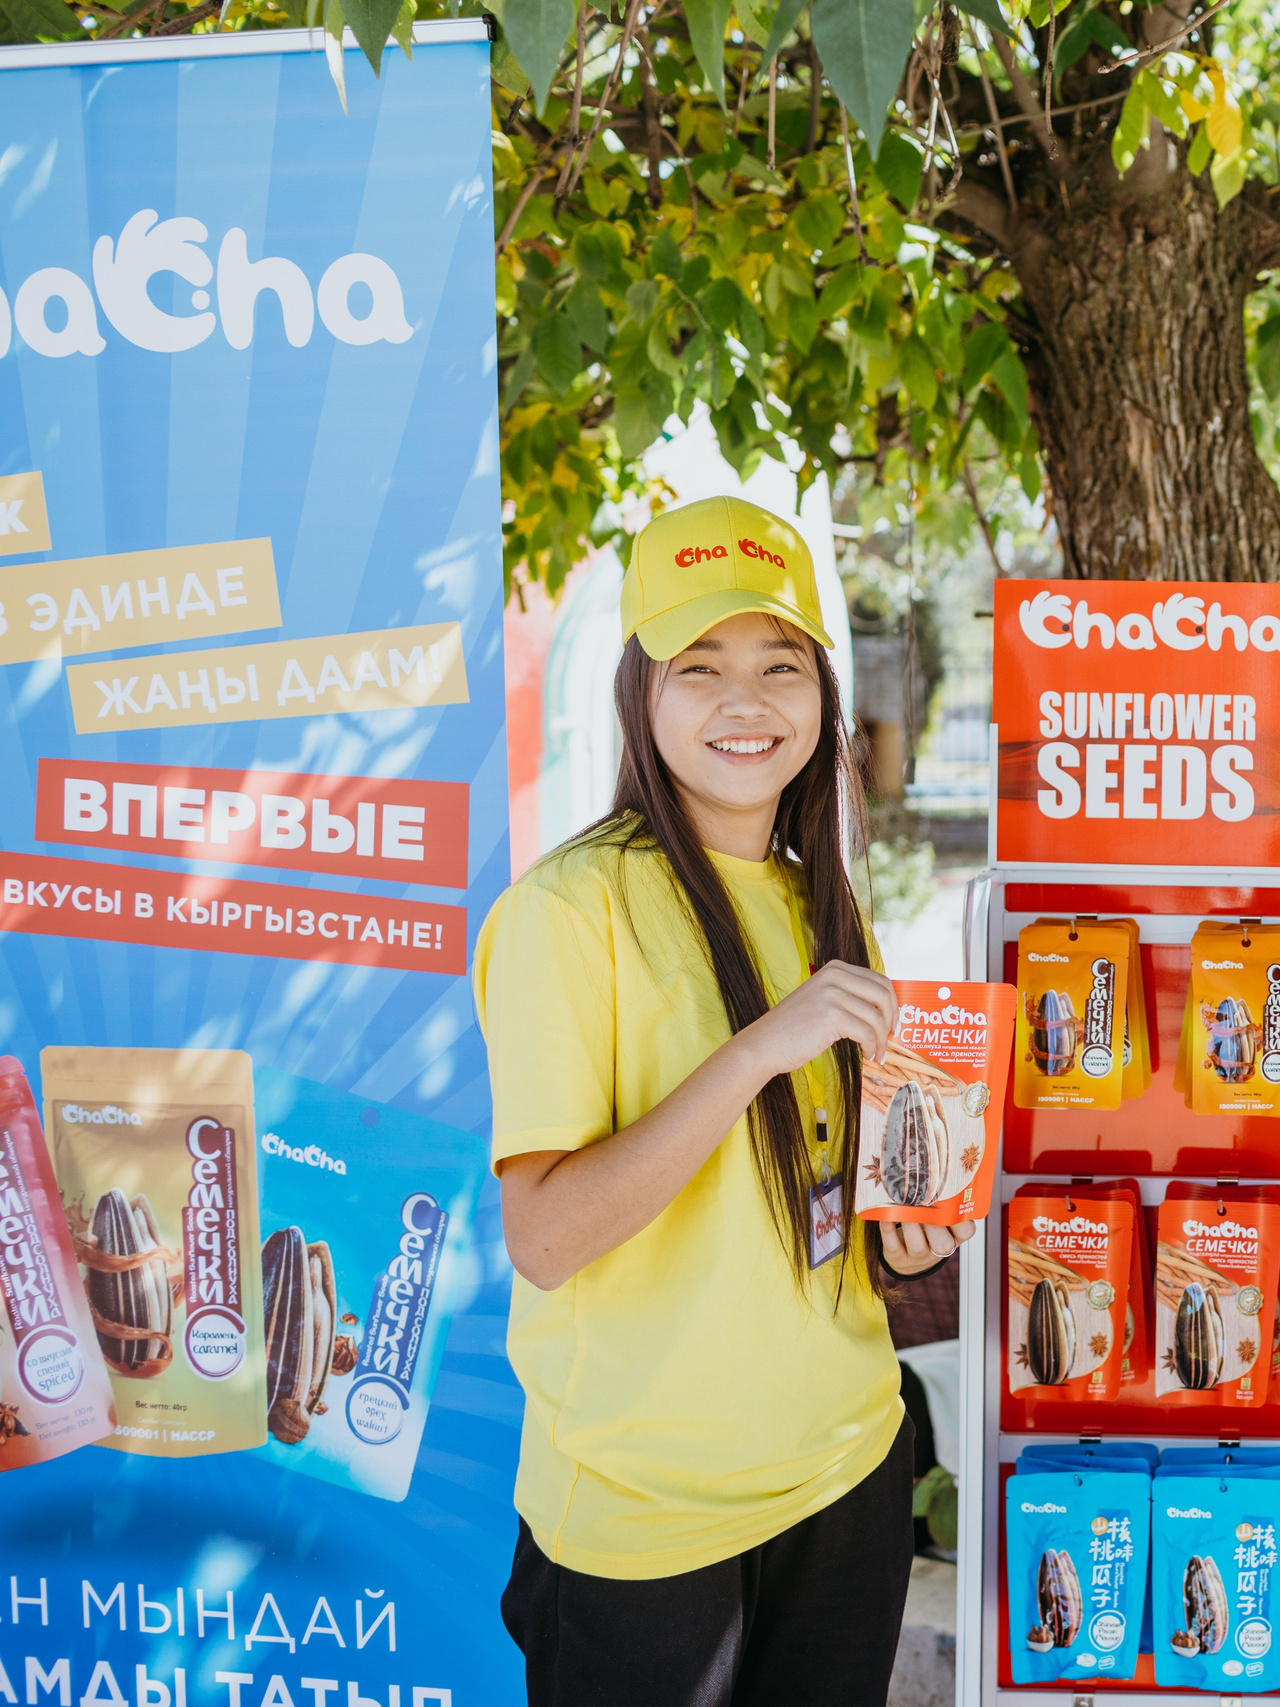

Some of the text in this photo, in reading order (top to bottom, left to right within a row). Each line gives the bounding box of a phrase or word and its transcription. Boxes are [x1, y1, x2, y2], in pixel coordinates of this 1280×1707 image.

[675, 538, 786, 570] Cha Cha
[26, 567, 249, 635] ЭДИНДЕ
[94, 644, 443, 718] ЖАҢЫ ДААМ!
[1039, 690, 1256, 742] SUNFLOWER
[1037, 741, 1255, 823] SEEDS
[63, 778, 426, 861] ВПЕРВЫЕ
[3, 878, 443, 950] ВКУСЫ В КЫРГЫЗСТАНЕ!
[1028, 952, 1069, 963] ChaCha
[1201, 960, 1244, 970] ChaCha
[1091, 958, 1108, 1044] Семечки
[899, 1004, 987, 1025] ChaCha
[900, 1028, 987, 1045] СЕМЕЧКИ
[62, 1104, 142, 1126] ChaCha
[261, 1132, 347, 1176] ChaCha
[188, 1118, 225, 1305] Семечки
[1033, 1215, 1108, 1234] ChaCha
[1182, 1219, 1258, 1239] ChaCha
[1036, 1235, 1109, 1249] СЕМЕЧКИ
[1186, 1239, 1258, 1254] СЕМЕЧКИ
[373, 1193, 437, 1377] Семечки
[192, 1342, 238, 1355] caramel
[38, 1367, 75, 1394] spiced
[170, 1430, 216, 1441] HACCP
[356, 1418, 388, 1434] walnut
[1021, 1502, 1067, 1513] ChaCha
[1166, 1507, 1212, 1519] ChaCha
[82, 1579, 396, 1654] МЫНДАЙ
